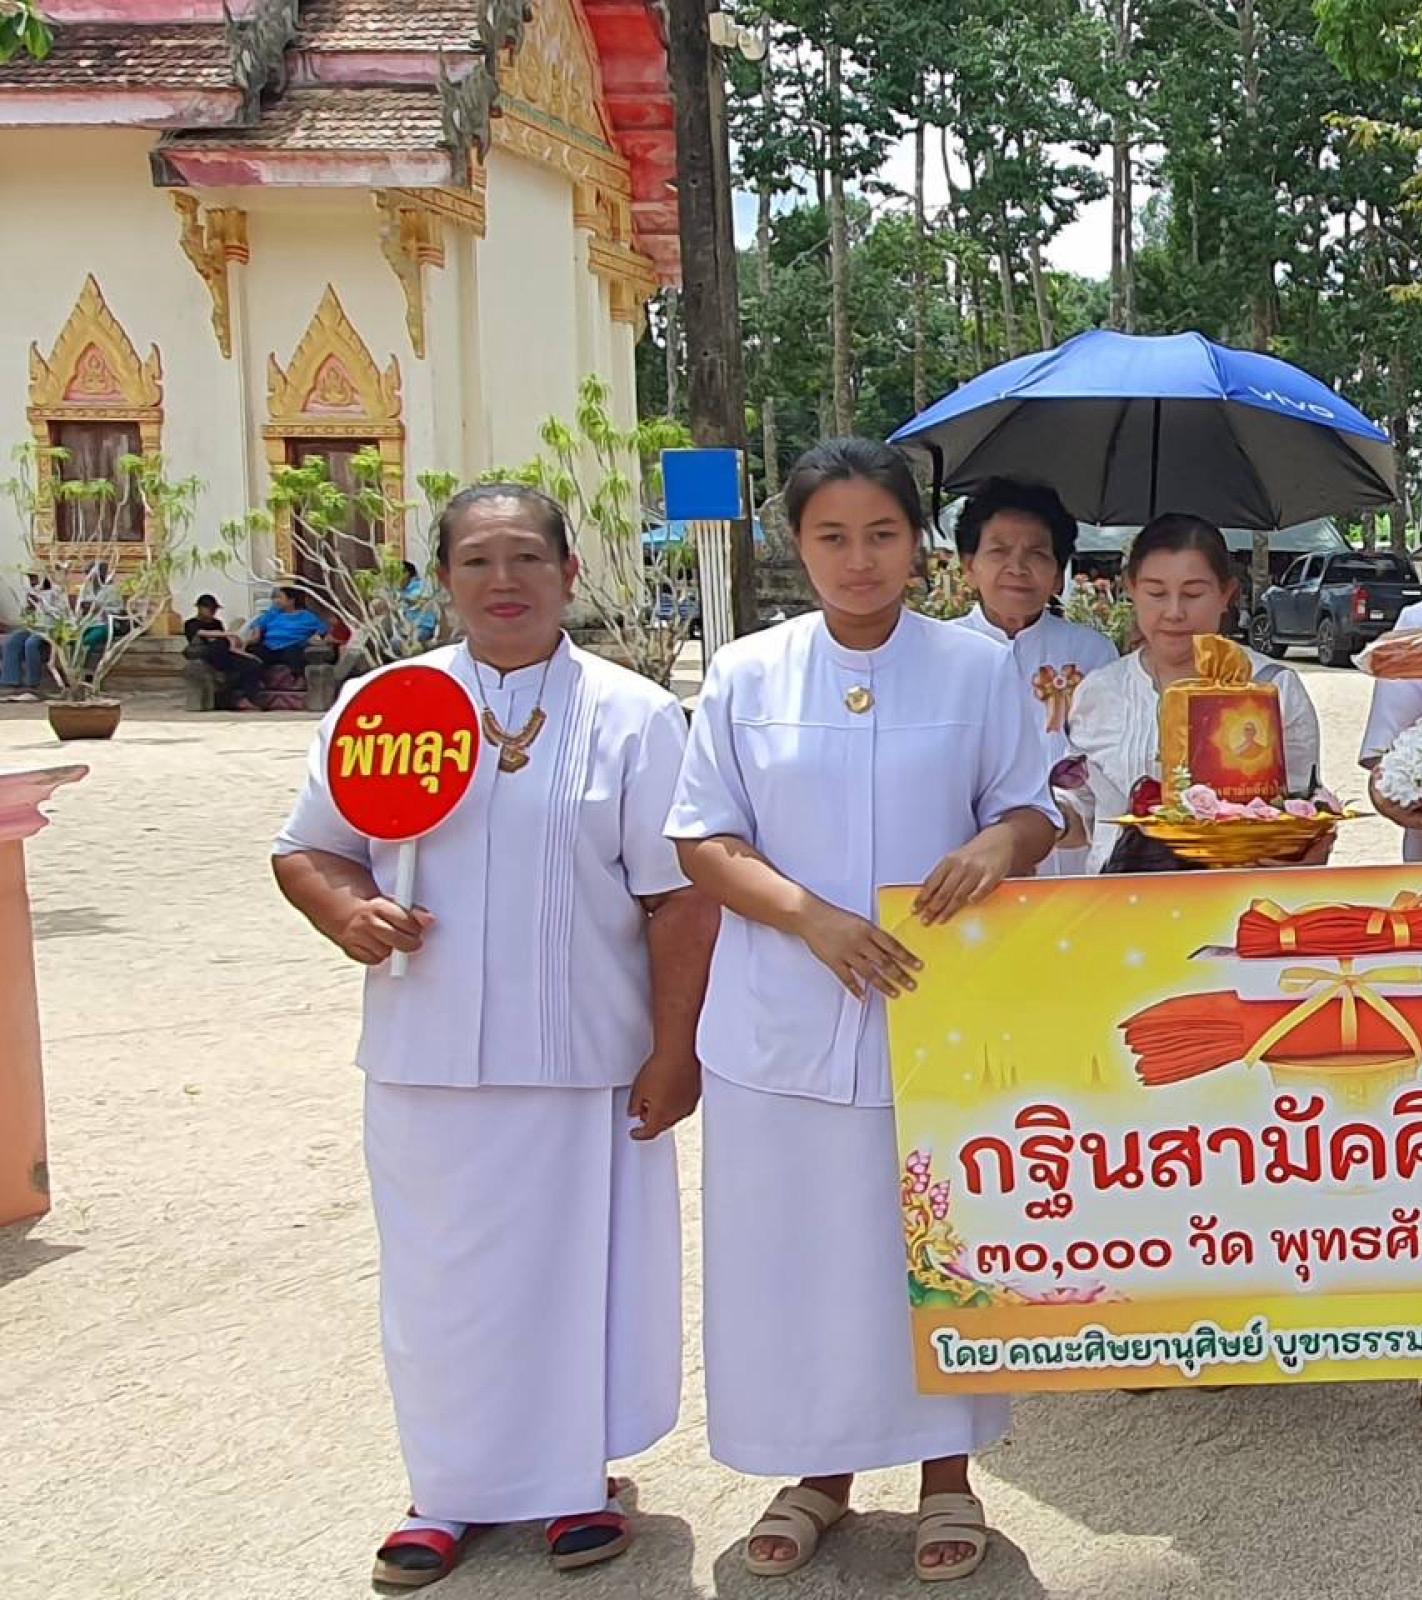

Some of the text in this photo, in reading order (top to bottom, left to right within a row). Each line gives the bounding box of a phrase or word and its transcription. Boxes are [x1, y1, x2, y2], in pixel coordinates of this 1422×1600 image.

[336, 714, 472, 794] พัทลุง
[977, 1238, 1172, 1278] ๓๐,๐๐๐
[1189, 1215, 1254, 1265] วัด
[936, 1333, 998, 1367] โดย
[1008, 1320, 1264, 1370] คณะศิษยานุศิษย์
